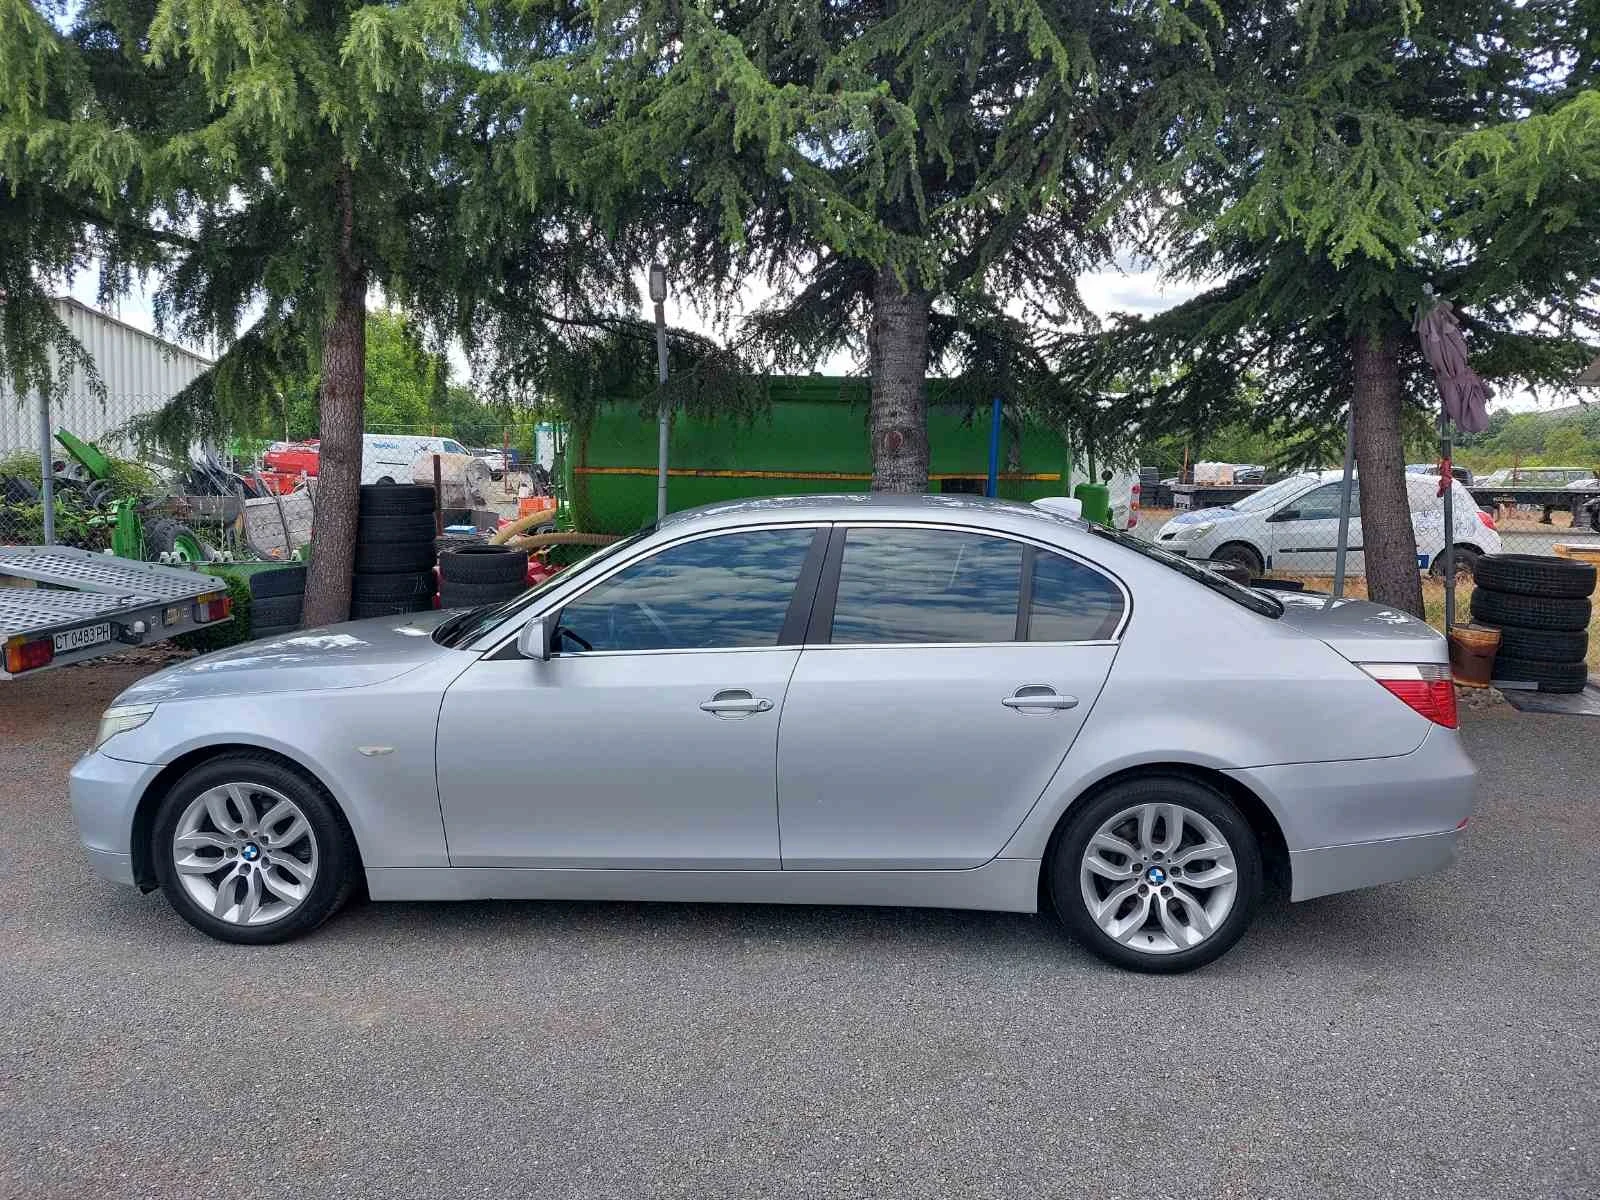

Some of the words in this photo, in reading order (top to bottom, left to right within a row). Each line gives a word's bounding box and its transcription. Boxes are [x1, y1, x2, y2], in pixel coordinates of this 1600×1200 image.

[55, 634, 69, 649] CT
[71, 628, 95, 646] 0483
[96, 624, 109, 640] PH
